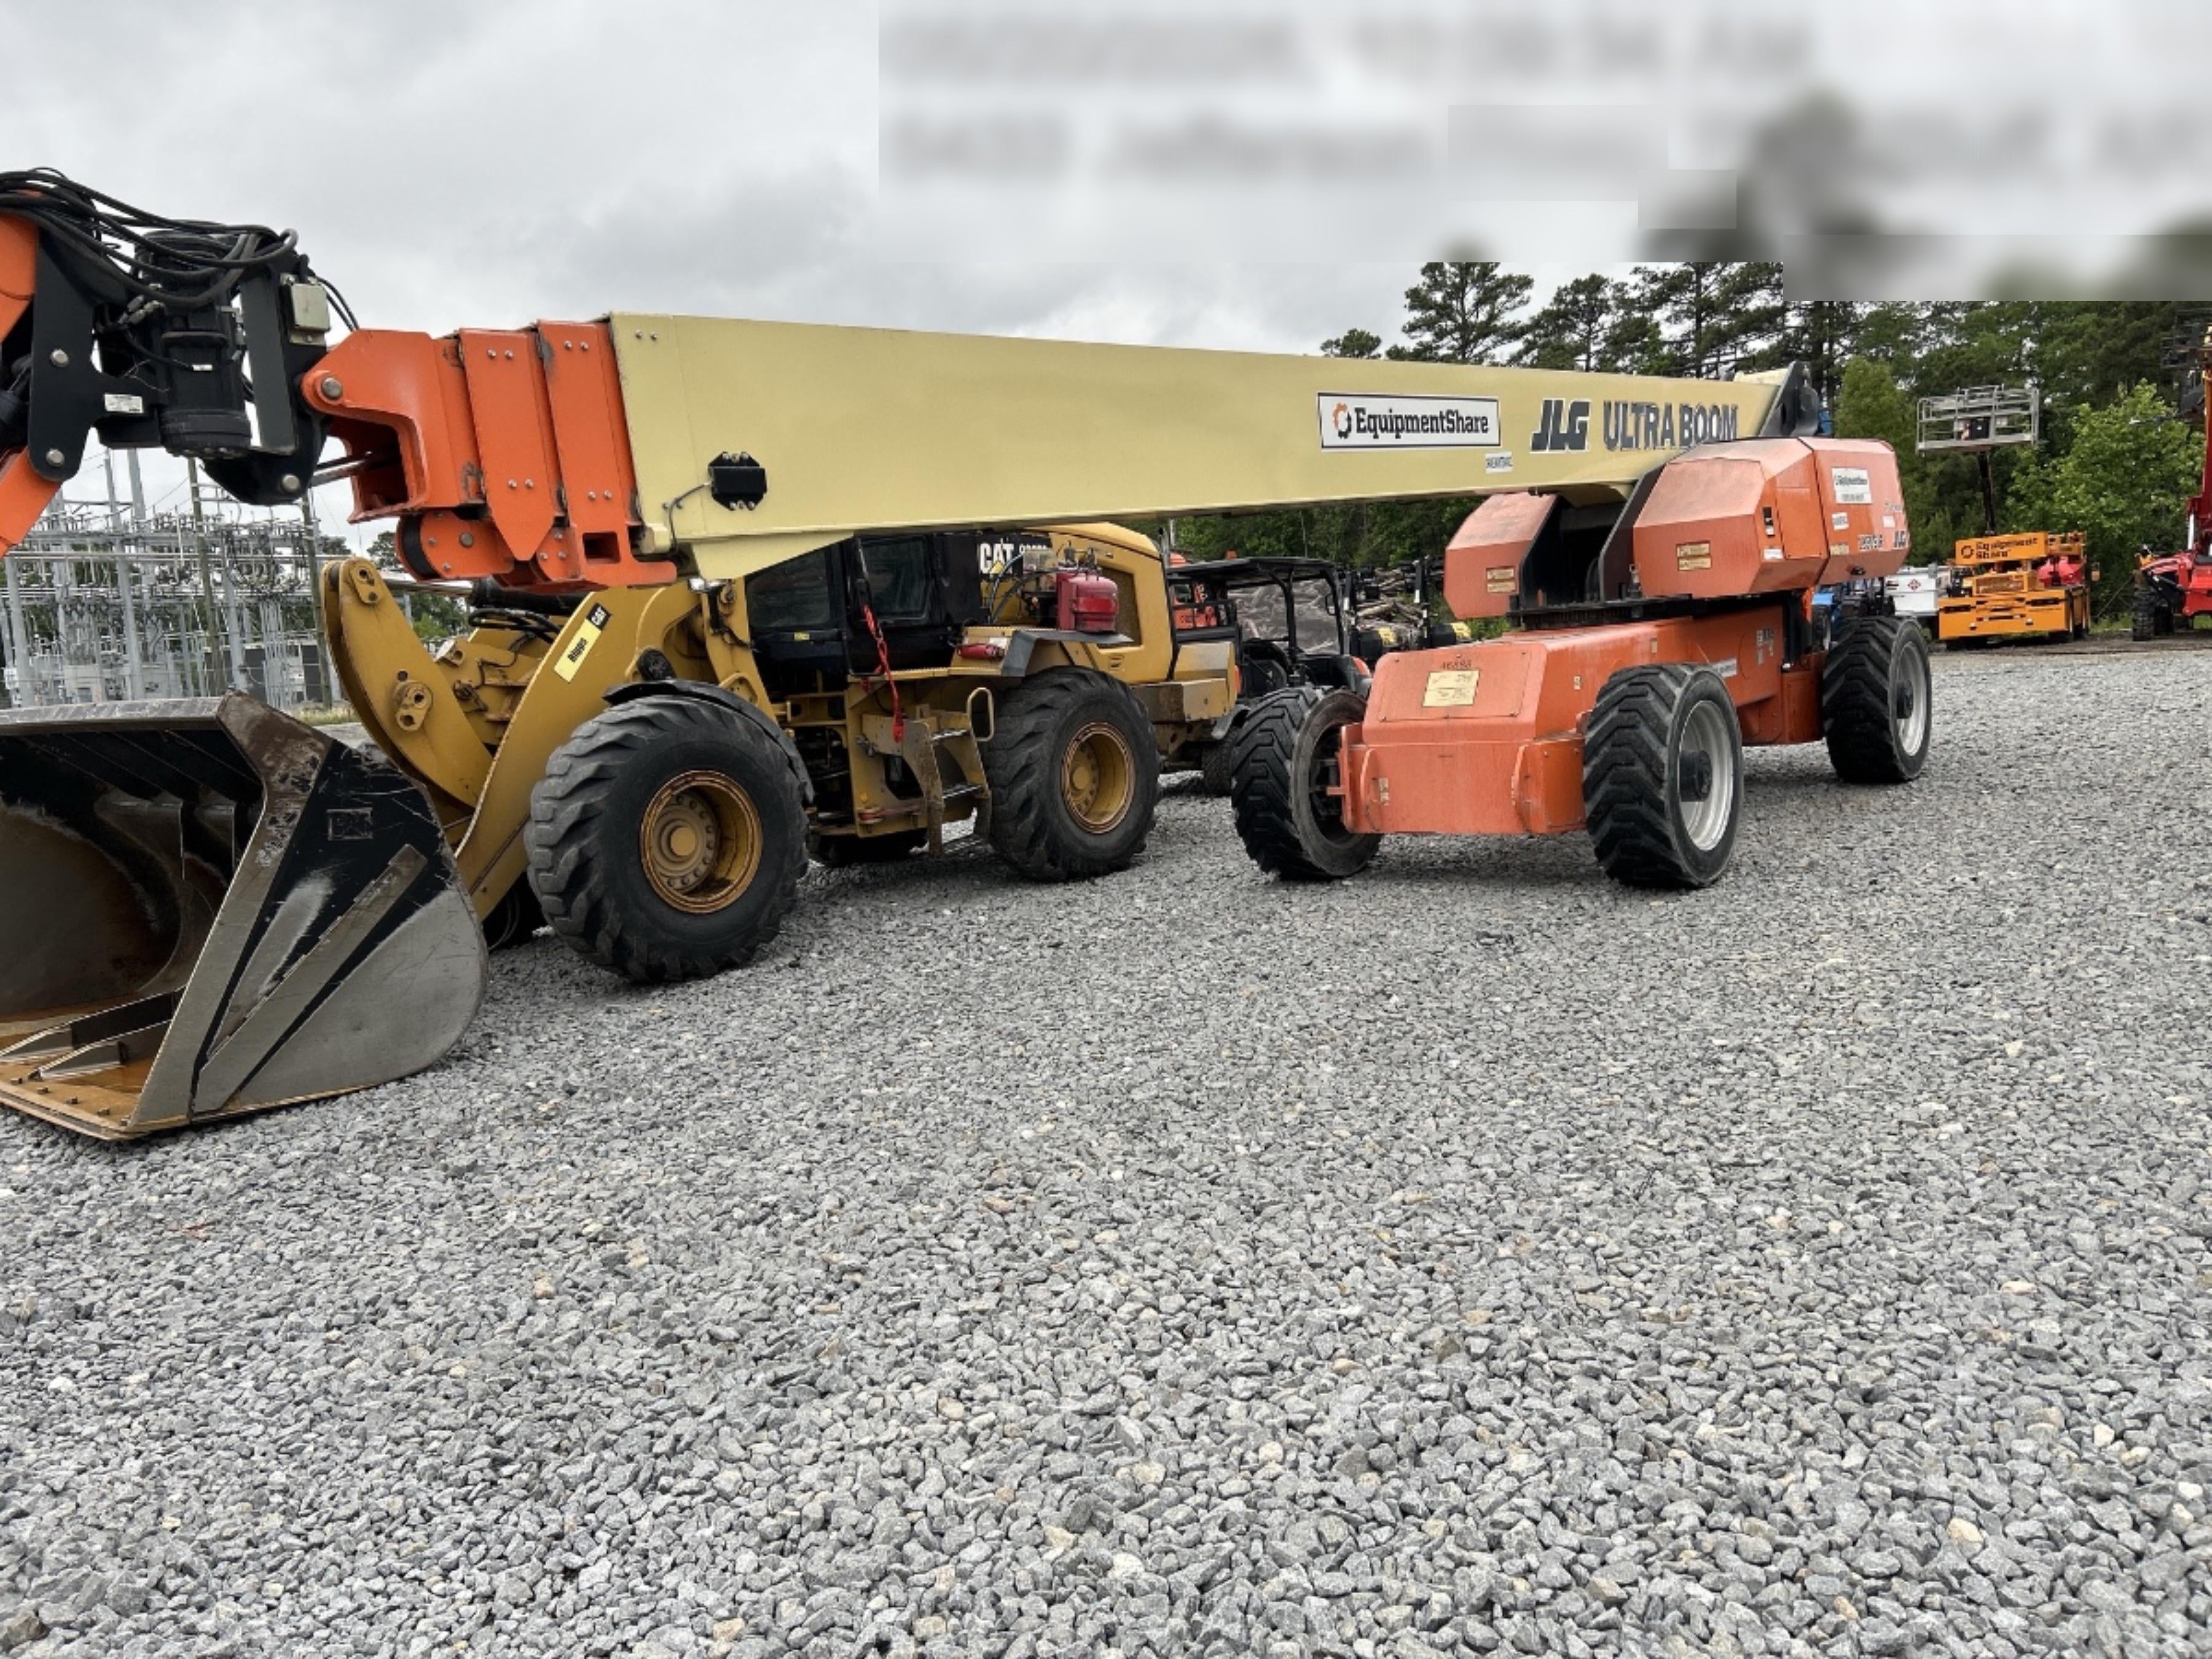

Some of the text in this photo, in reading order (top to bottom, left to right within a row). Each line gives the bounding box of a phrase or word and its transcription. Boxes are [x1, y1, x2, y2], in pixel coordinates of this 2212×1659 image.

[1354, 407, 1489, 439] EquipmentShare
[1531, 399, 1738, 452] JLG ULTRA BOOM
[1976, 538, 2038, 551] Equipment
[1976, 550, 2009, 559] Share
[980, 543, 1014, 574] CAT
[591, 605, 608, 626] CAT
